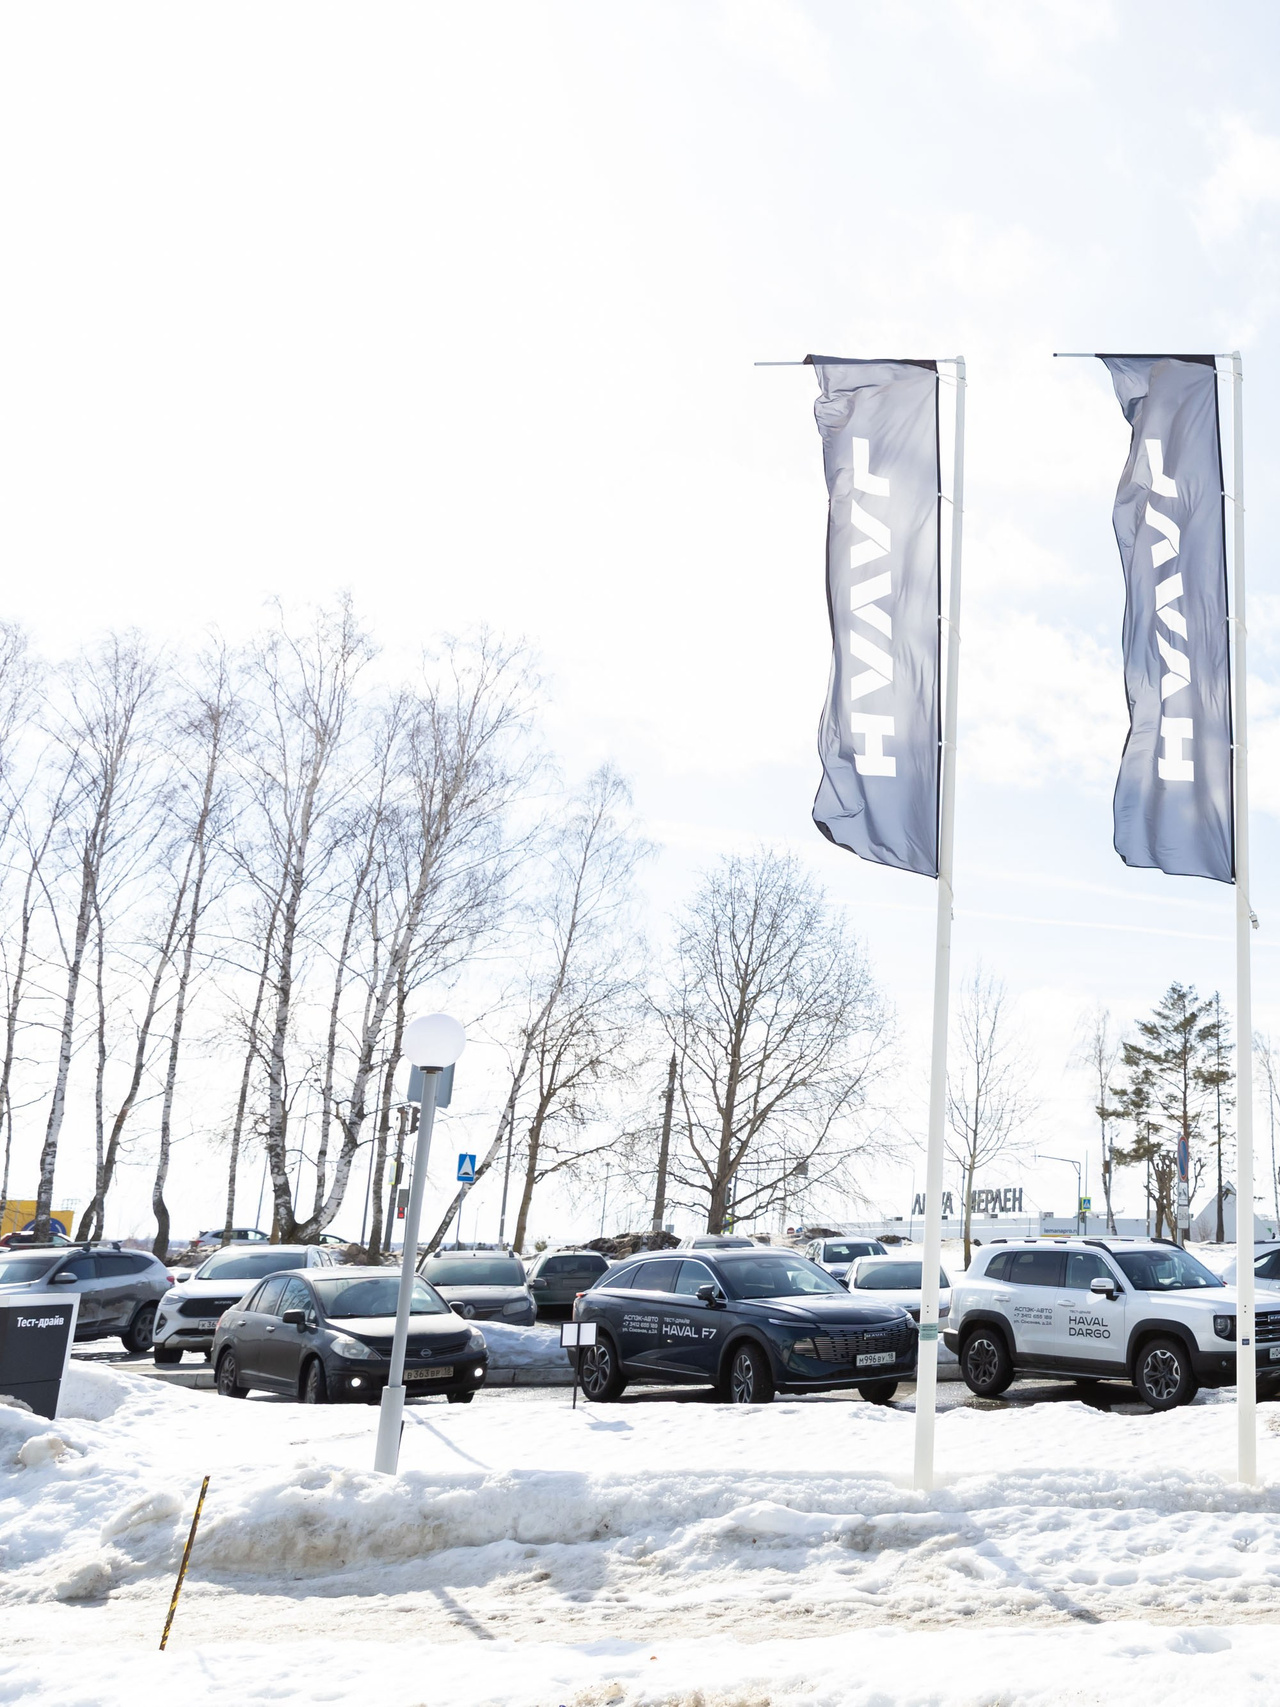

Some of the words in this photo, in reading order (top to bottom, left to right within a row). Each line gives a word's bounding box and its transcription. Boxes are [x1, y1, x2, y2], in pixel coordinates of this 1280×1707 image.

[17, 1315, 64, 1328] Тест-драйв
[1068, 1315, 1109, 1327] HAVAL
[662, 1324, 699, 1338] HAVAL
[701, 1327, 717, 1340] F7
[1068, 1327, 1111, 1339] DARGO
